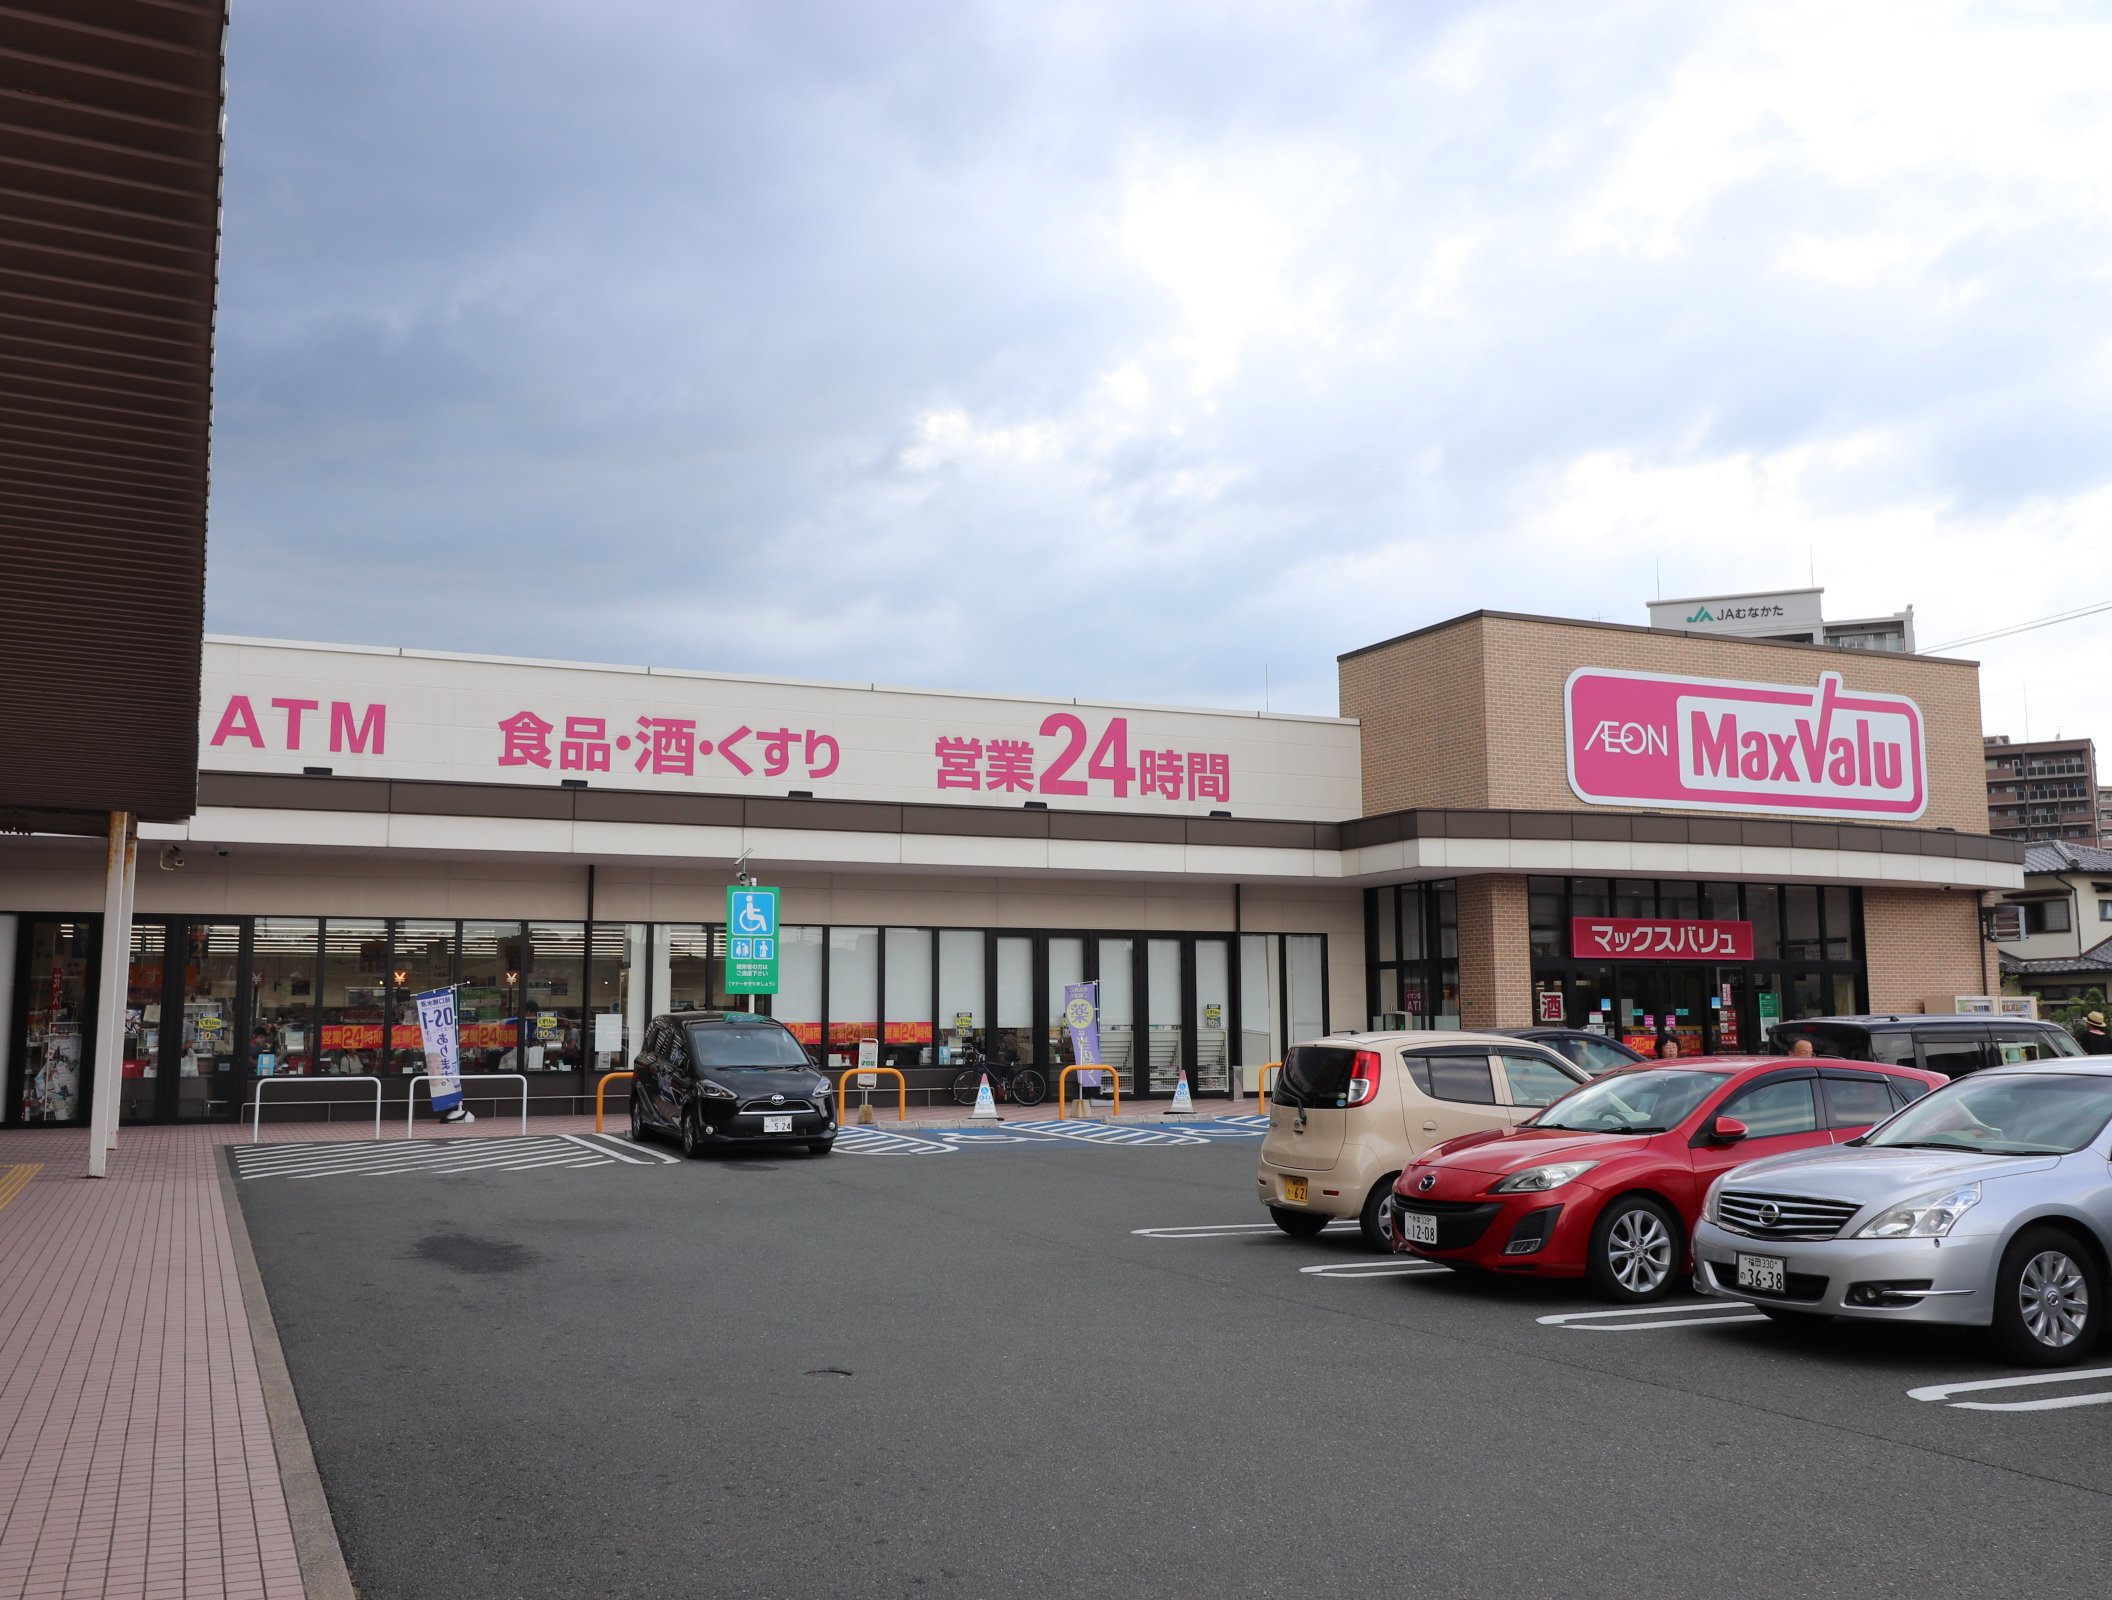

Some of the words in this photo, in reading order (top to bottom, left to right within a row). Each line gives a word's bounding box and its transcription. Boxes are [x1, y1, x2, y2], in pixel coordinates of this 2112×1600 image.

[1716, 605, 1784, 621] JAむなかた
[209, 695, 386, 755] ATM
[1691, 678, 1903, 789] MaxValu
[498, 711, 840, 779] 食品・酒・くすり
[935, 712, 1230, 803] 営業24時間
[1591, 925, 1736, 954] マックスバリュ
[1541, 994, 1562, 1019] 酒
[1412, 1225, 1435, 1242] 12-08
[1747, 1268, 1783, 1290] 36-38
